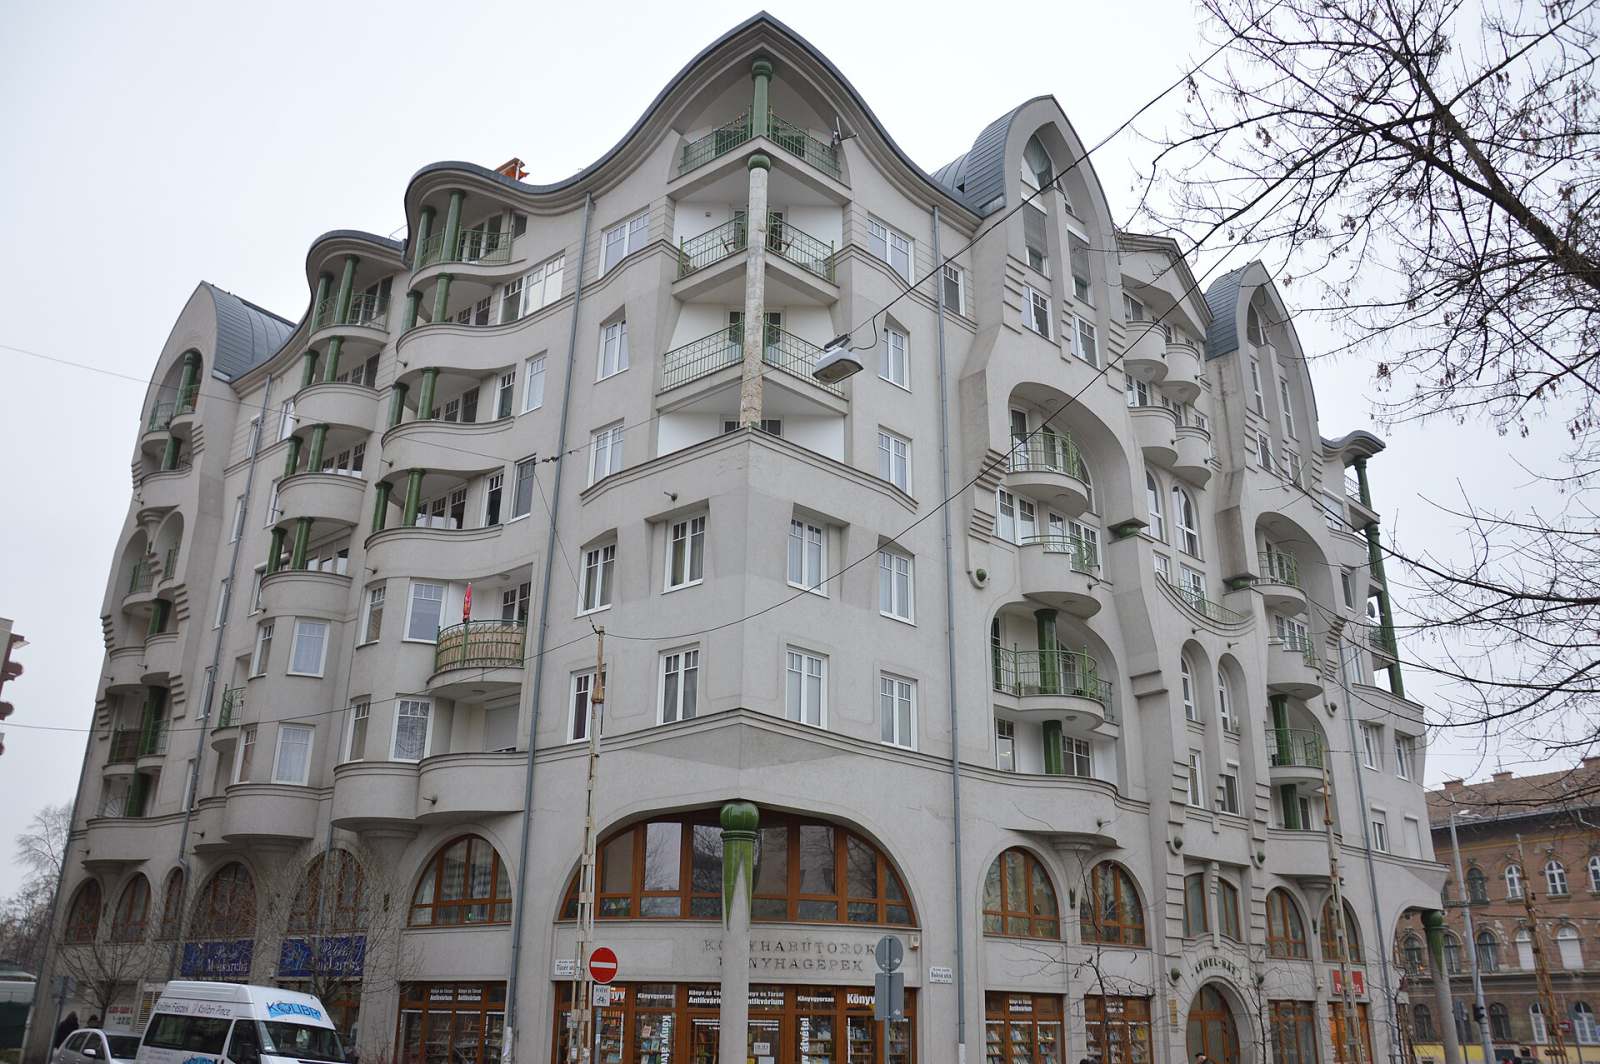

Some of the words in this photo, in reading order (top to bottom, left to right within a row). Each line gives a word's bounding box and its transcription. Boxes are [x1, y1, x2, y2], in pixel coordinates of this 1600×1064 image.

[703, 936, 875, 954] KYHABÚTOROK
[718, 955, 863, 972] NYHAGÉPEK
[688, 996, 721, 1004] Antikvári
[266, 1002, 322, 1018] KOLIBRI
